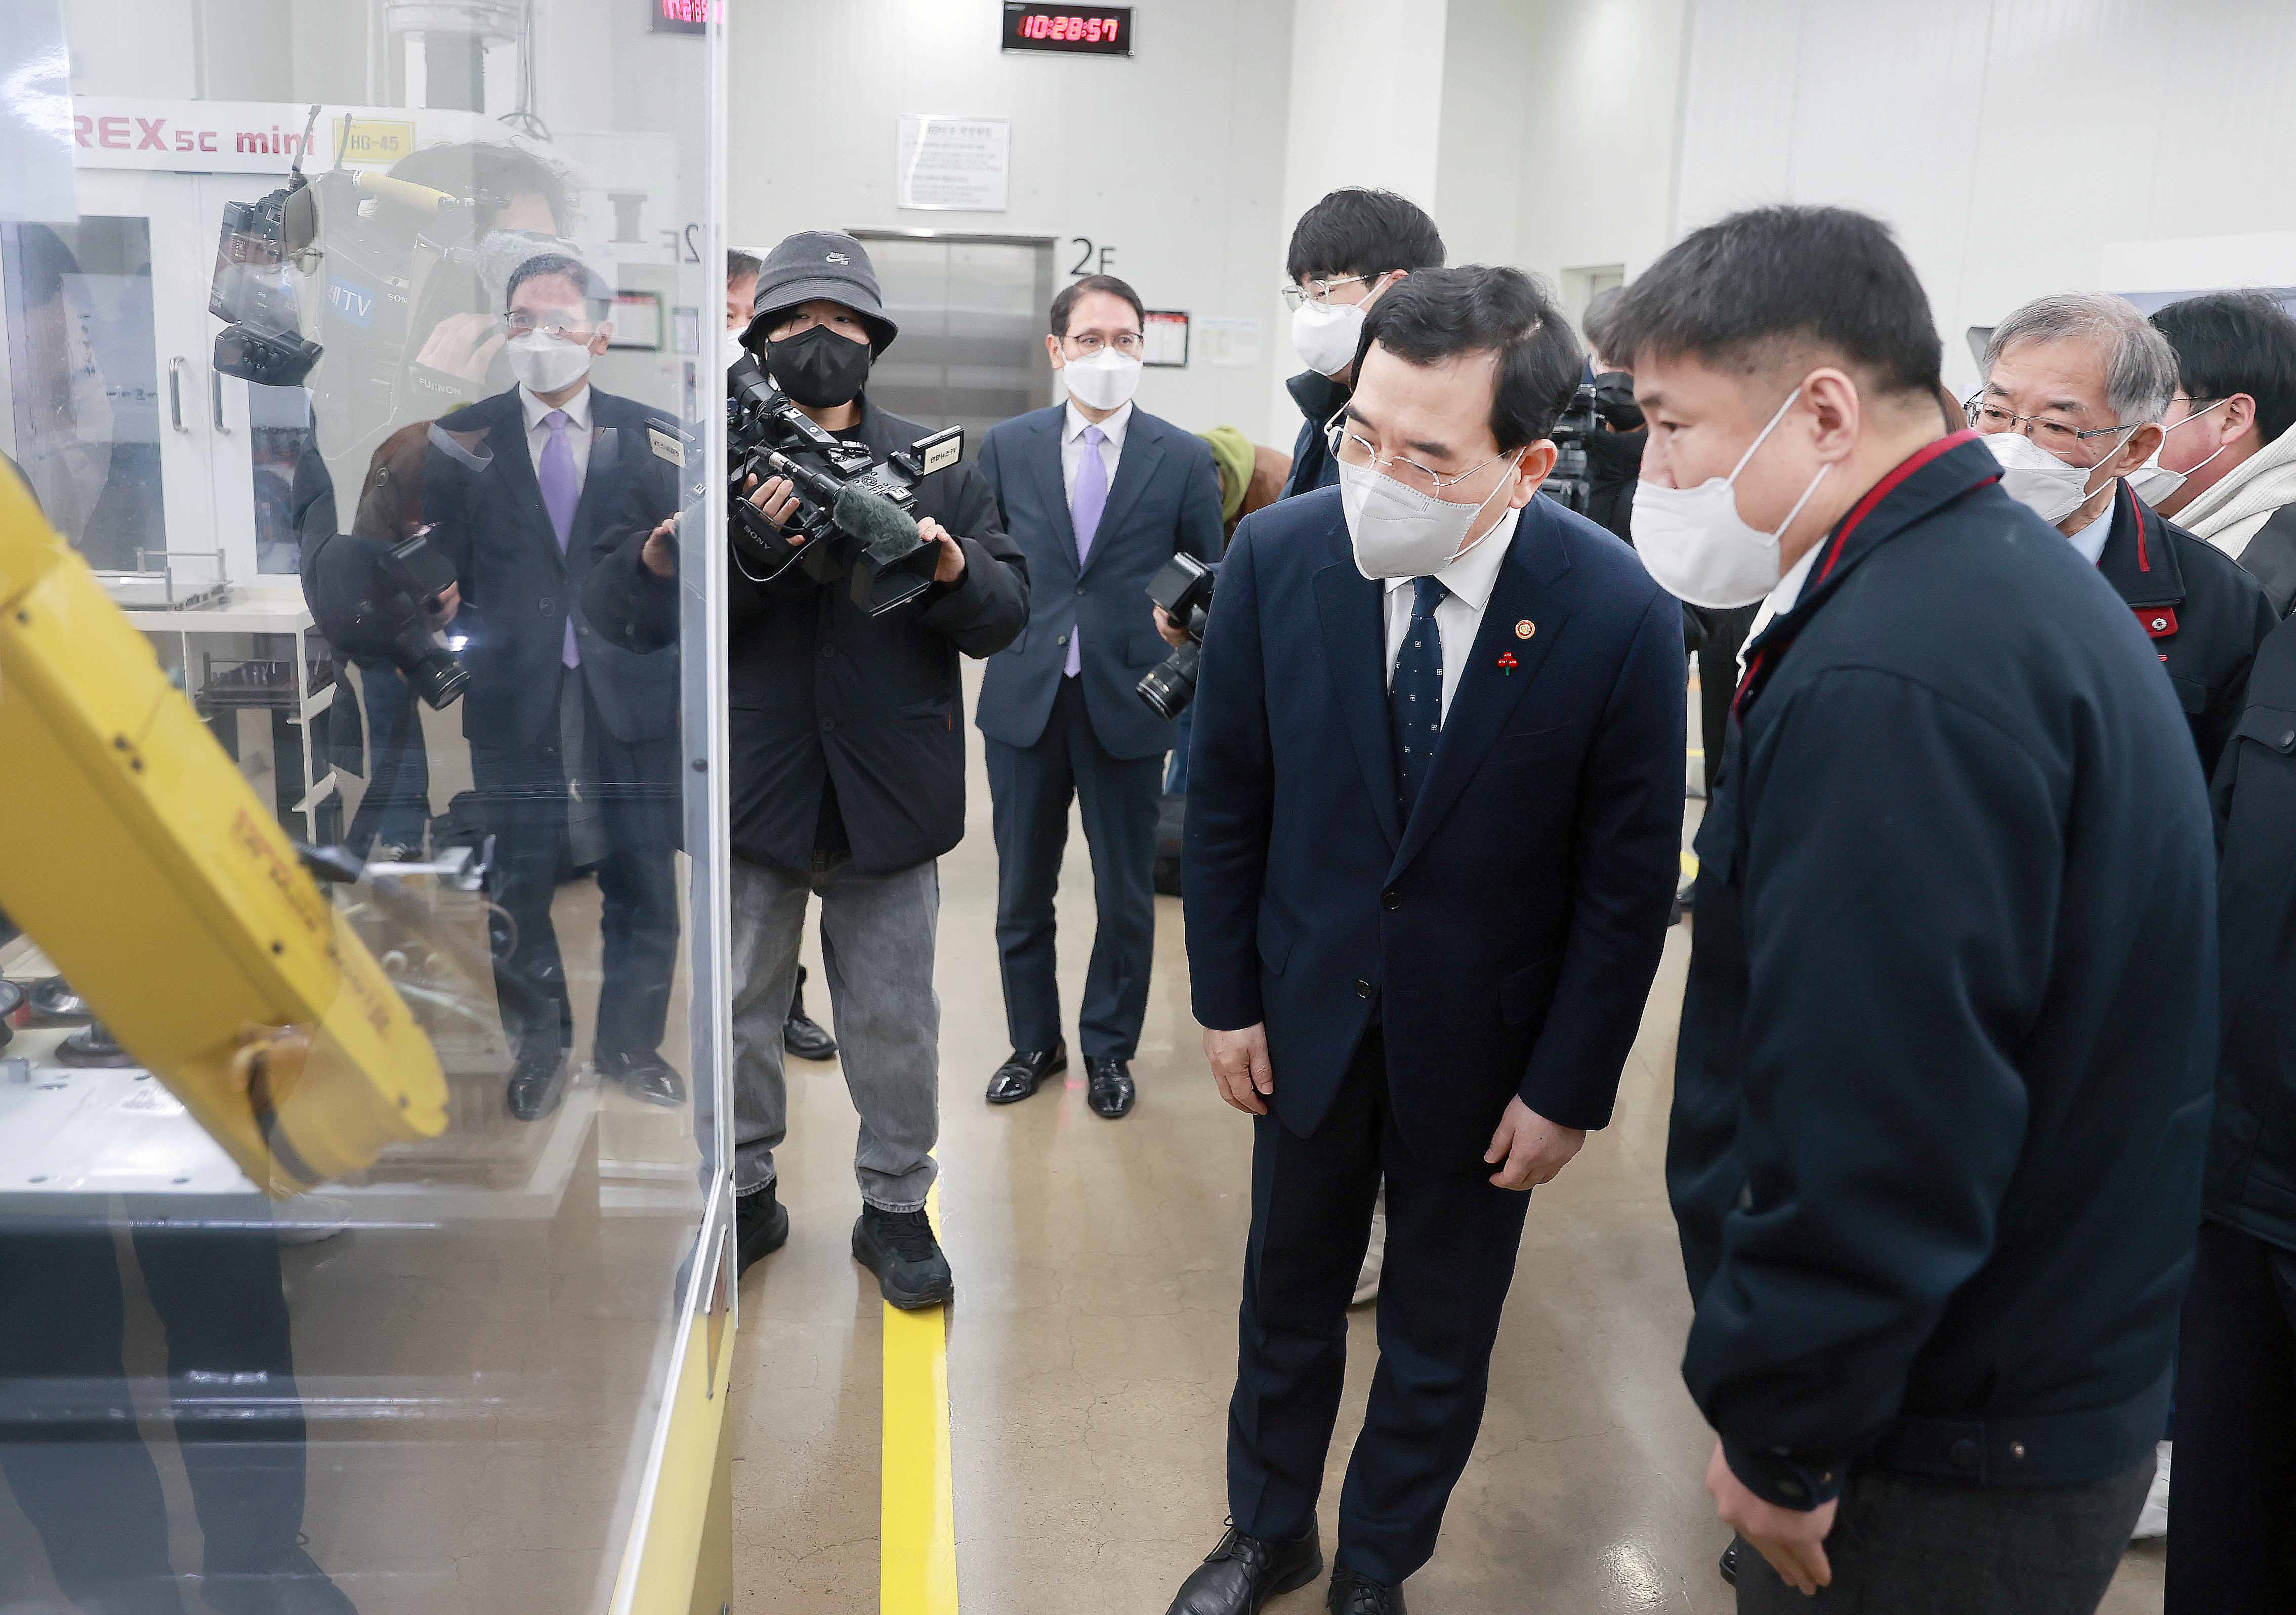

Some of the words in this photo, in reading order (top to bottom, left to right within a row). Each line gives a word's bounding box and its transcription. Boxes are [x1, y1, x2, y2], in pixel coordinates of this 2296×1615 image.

[1024, 15, 1119, 42] 10:28:57
[351, 135, 399, 151] HG-45
[1065, 238, 1116, 276] 2F
[388, 293, 408, 304] SON
[419, 377, 462, 395] FUJINON
